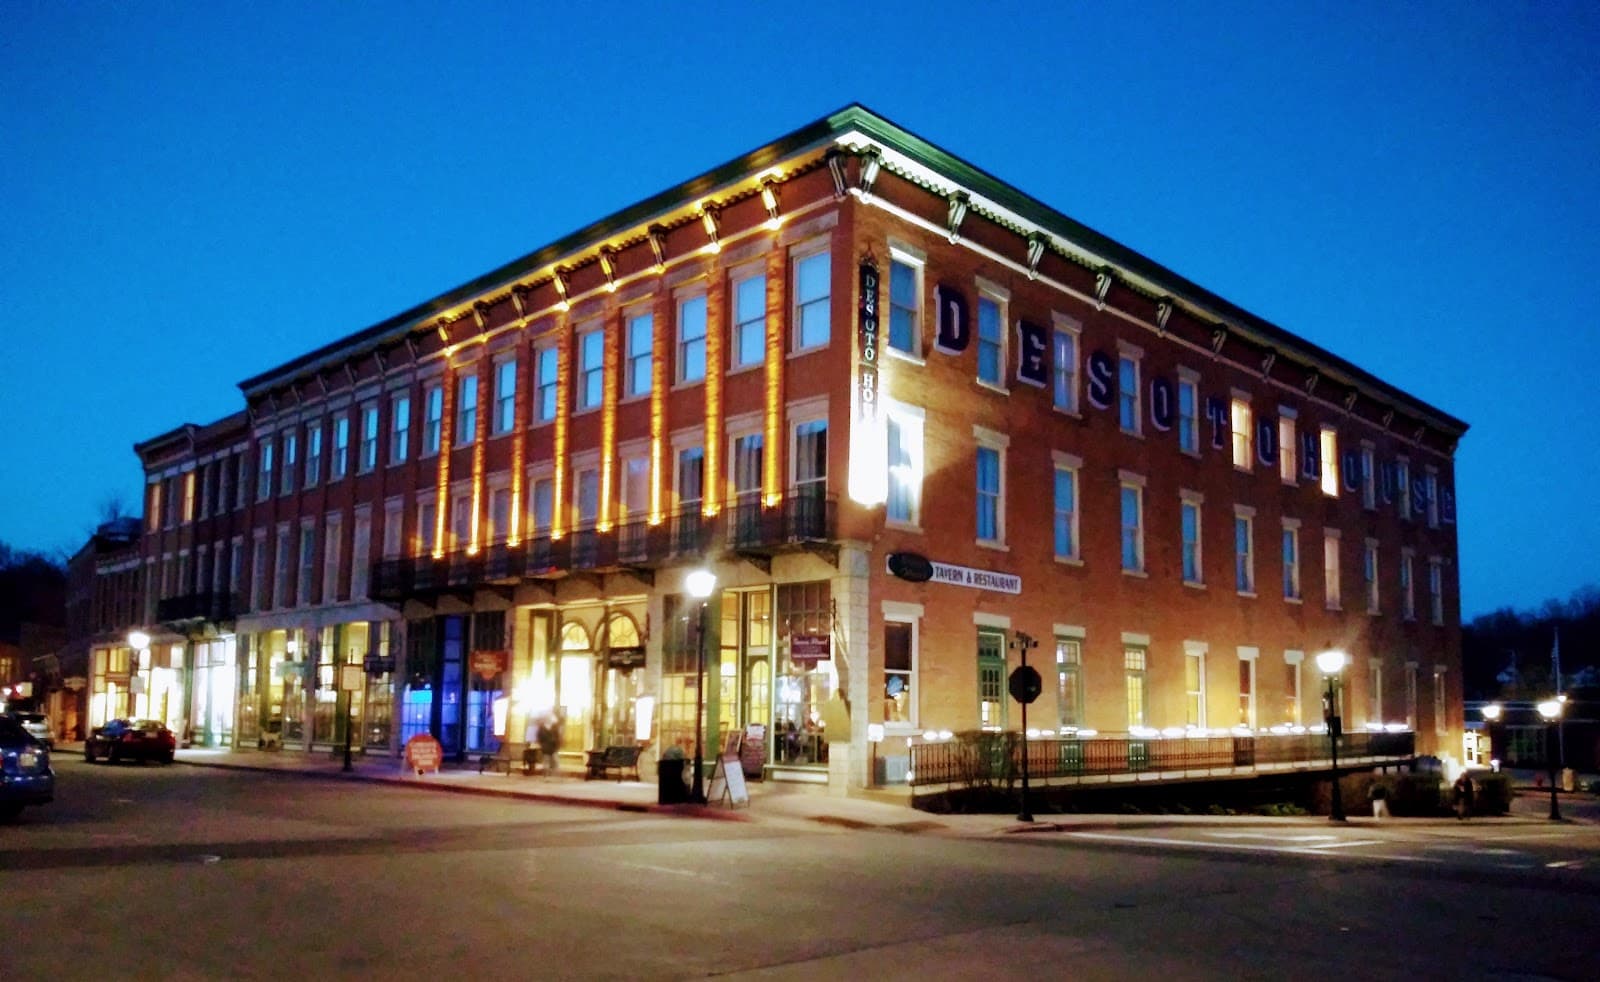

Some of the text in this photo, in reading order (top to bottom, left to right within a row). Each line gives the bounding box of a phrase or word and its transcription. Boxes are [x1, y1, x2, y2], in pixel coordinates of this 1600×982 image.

[935, 566, 963, 581] TAVERN
[966, 570, 972, 584] &
[974, 573, 1017, 590] RESTAURANT
